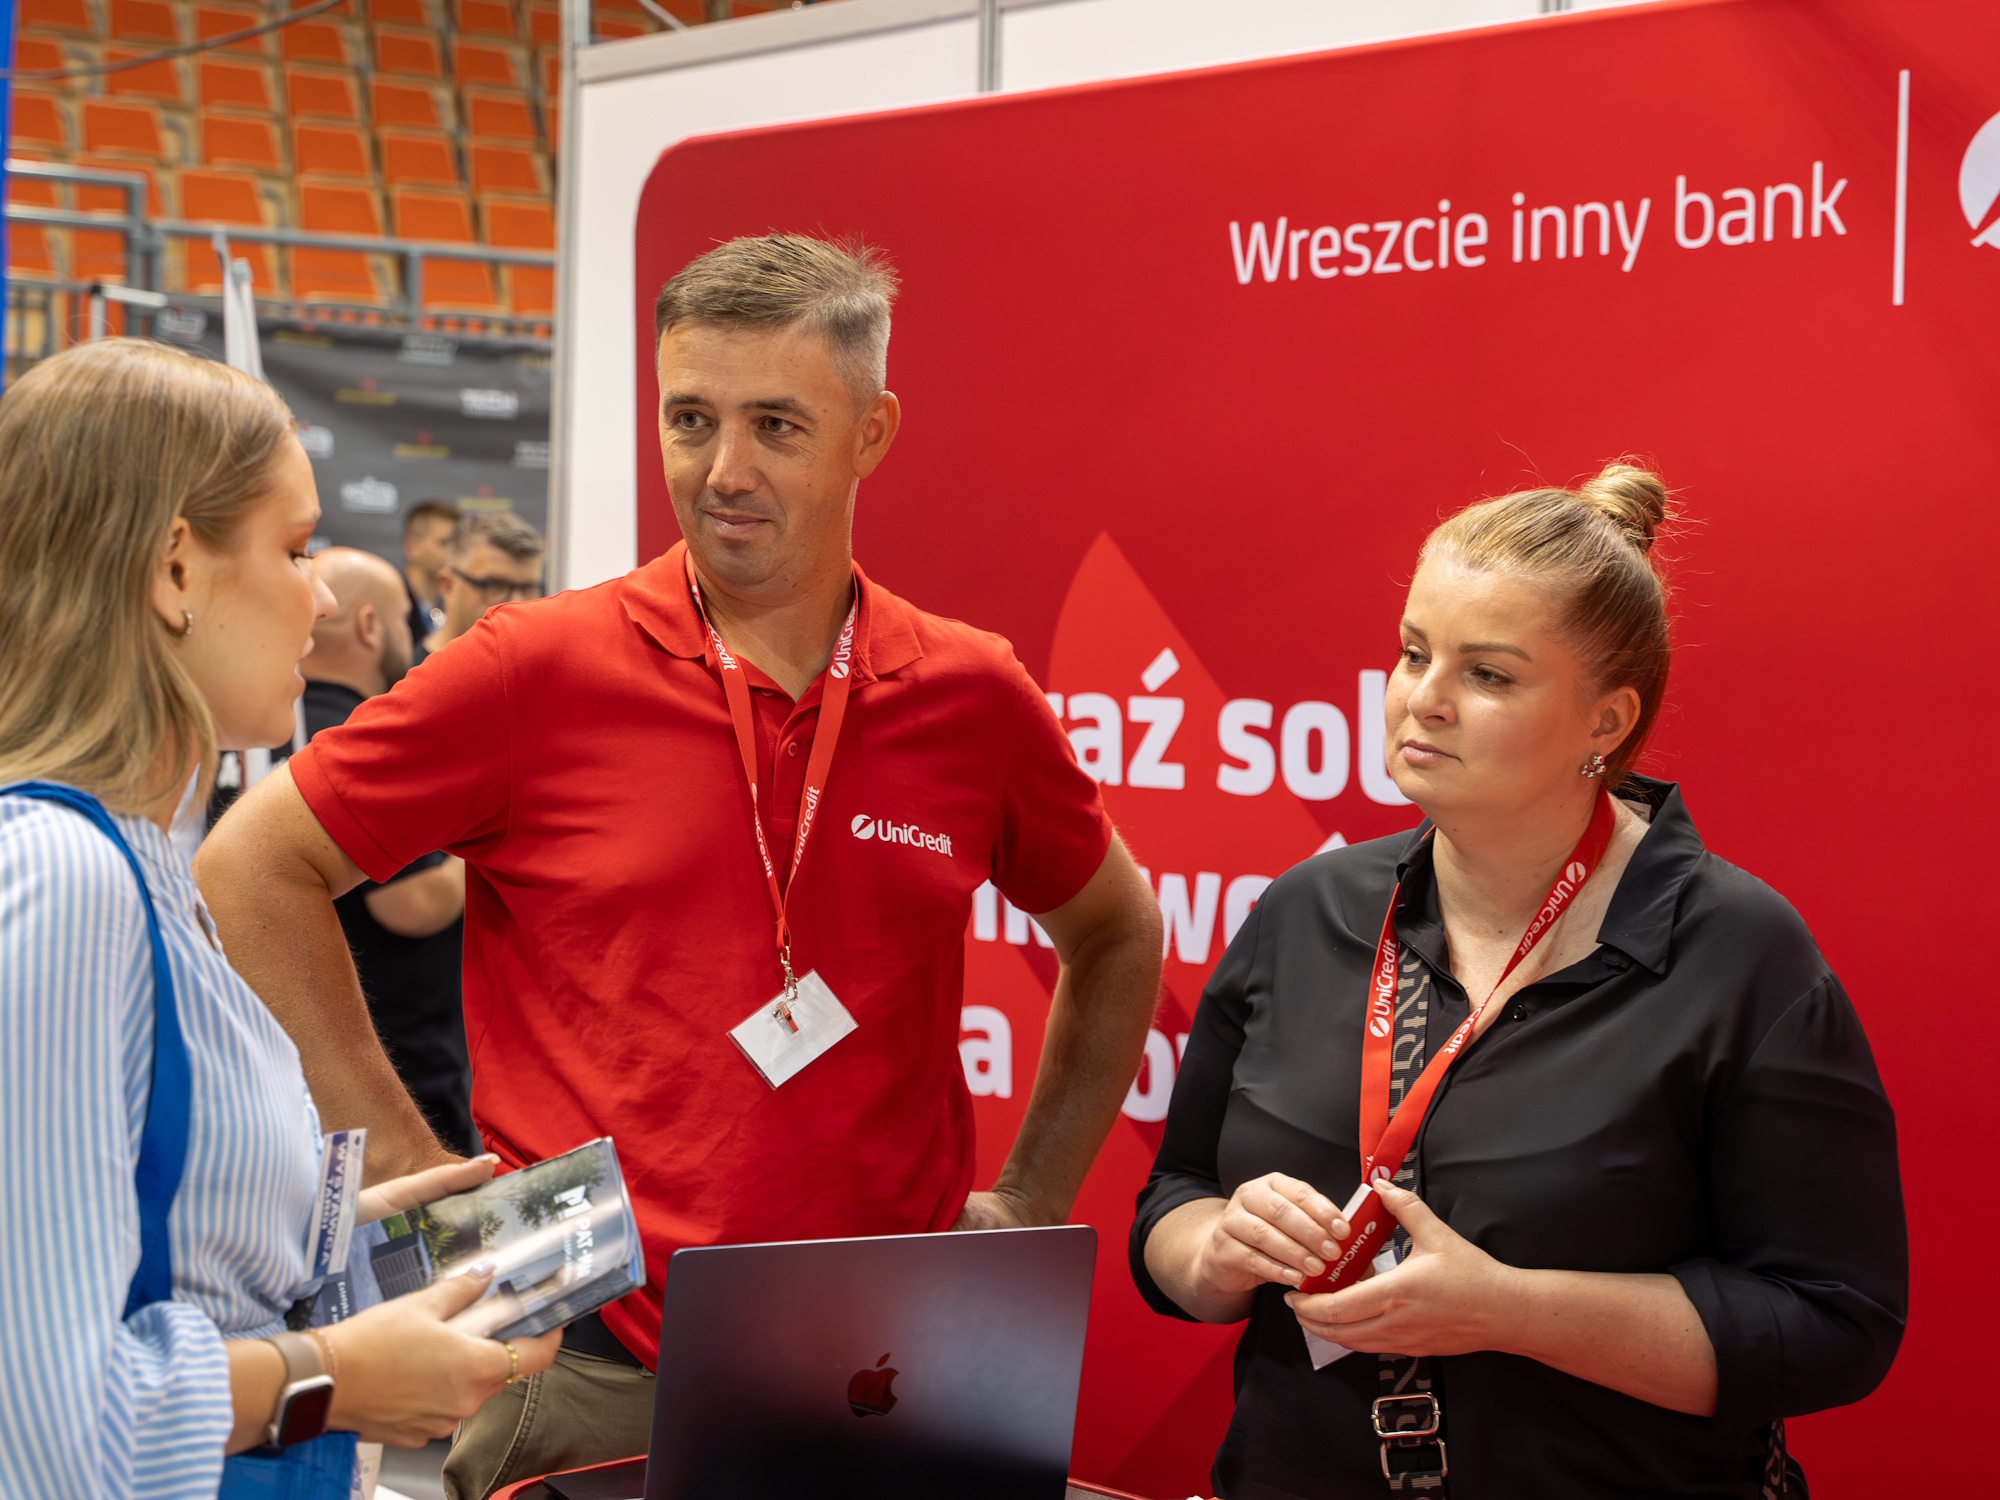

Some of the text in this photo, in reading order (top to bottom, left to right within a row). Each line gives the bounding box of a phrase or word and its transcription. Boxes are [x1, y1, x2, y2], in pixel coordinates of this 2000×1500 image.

[1229, 160, 1848, 285] Wreszcie inny bank
[877, 819, 953, 858] UniCredit
[1517, 880, 1574, 956] UniCredit
[1373, 939, 1397, 1016] UniCredit
[320, 1140, 348, 1267] WYSTAWCA
[1327, 1233, 1368, 1283] UniCredit
